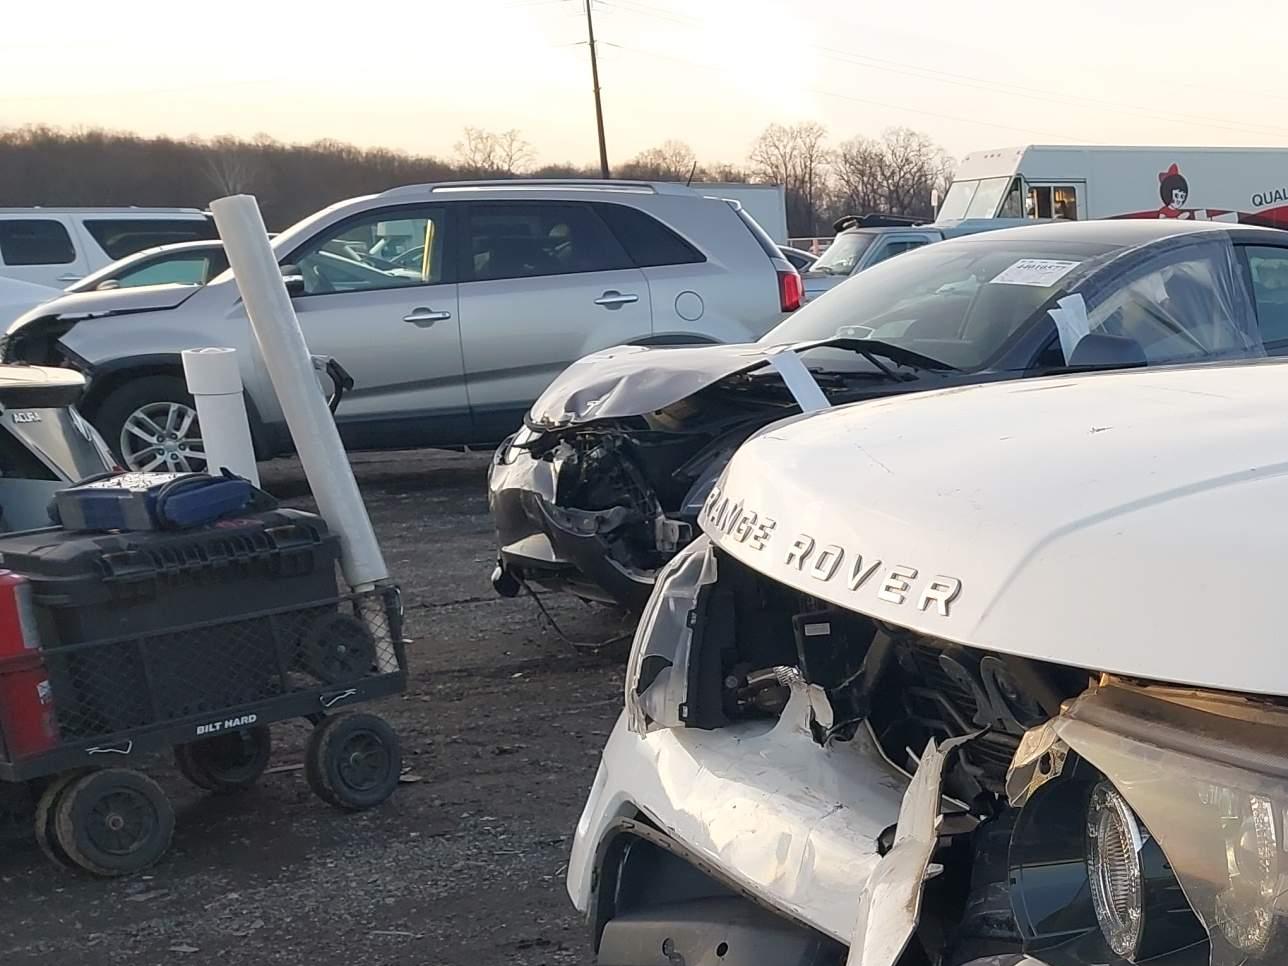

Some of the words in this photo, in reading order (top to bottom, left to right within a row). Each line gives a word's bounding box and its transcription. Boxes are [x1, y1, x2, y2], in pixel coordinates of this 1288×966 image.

[703, 486, 777, 551] RANGE
[784, 533, 962, 617] ROVER
[196, 721, 223, 736] BILT
[224, 714, 257, 729] HARD
